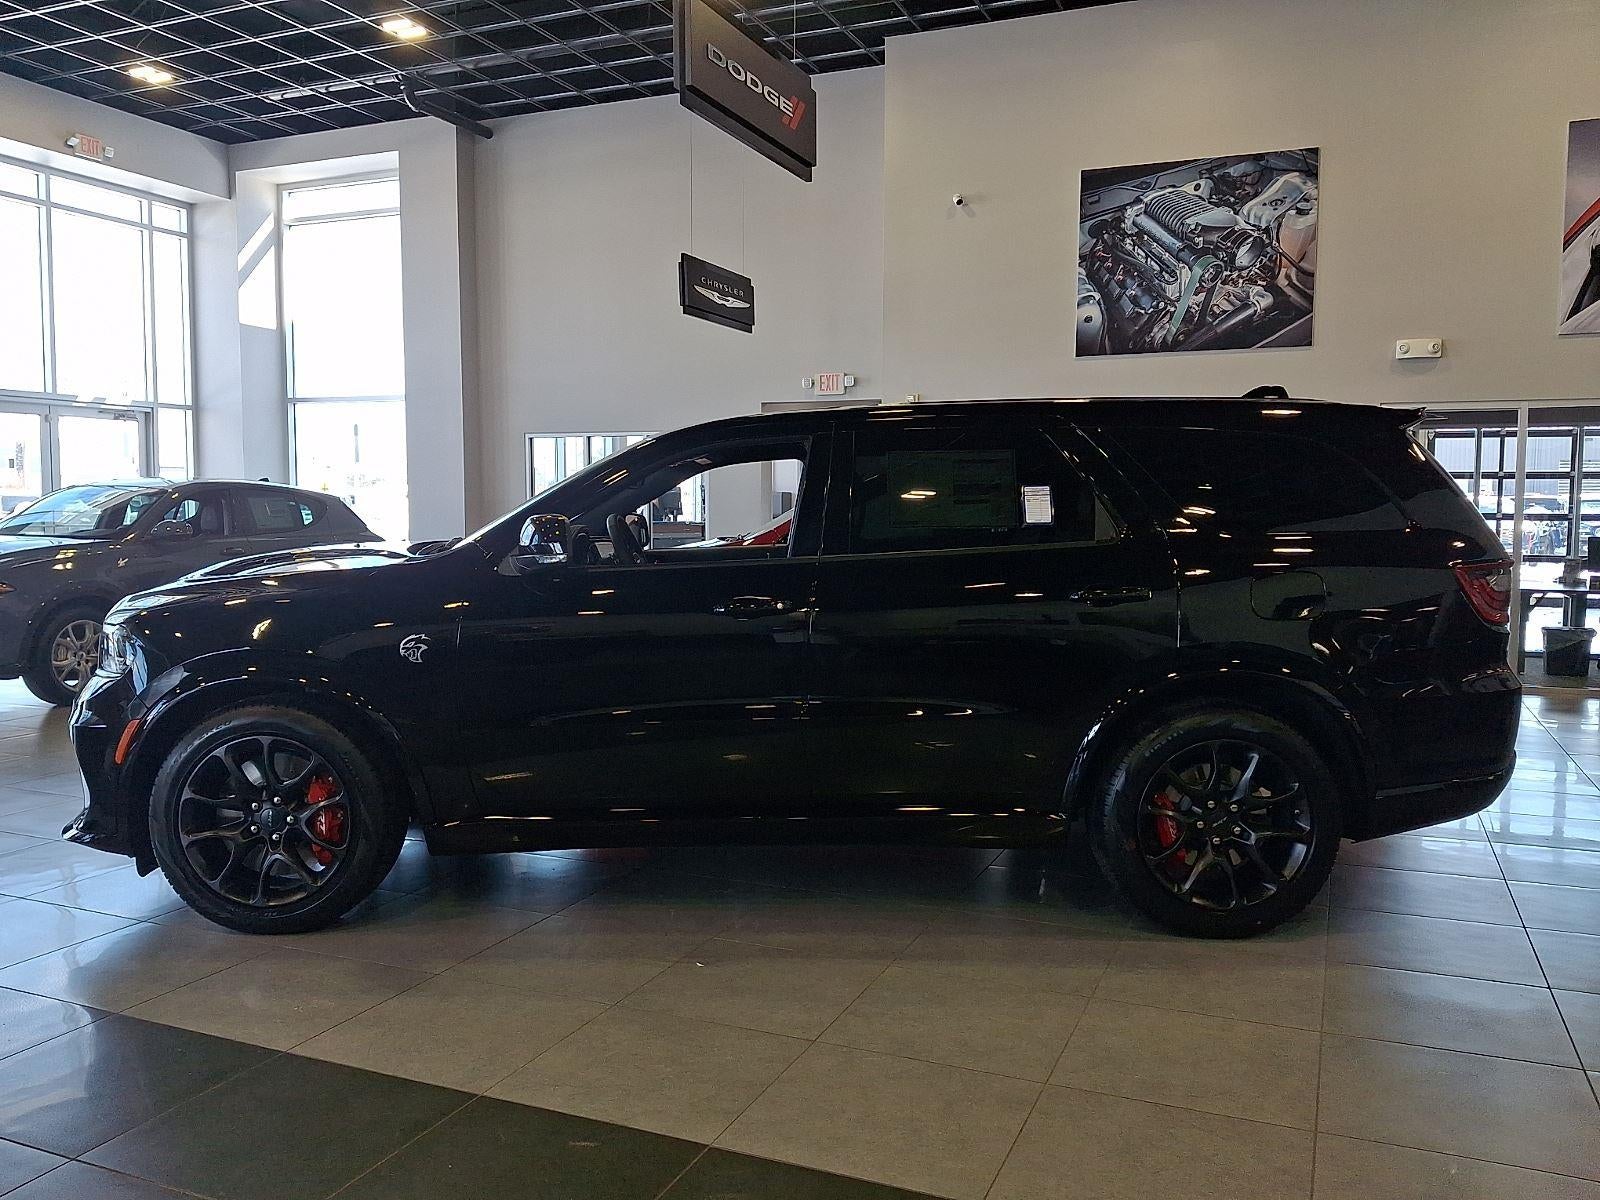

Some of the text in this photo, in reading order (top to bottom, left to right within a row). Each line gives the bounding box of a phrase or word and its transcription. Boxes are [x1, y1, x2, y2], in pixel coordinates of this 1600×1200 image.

[706, 43, 794, 118] DODGE
[80, 136, 100, 156] EXIT
[701, 276, 744, 298] CHRYSLER
[819, 374, 841, 391] EXIT
